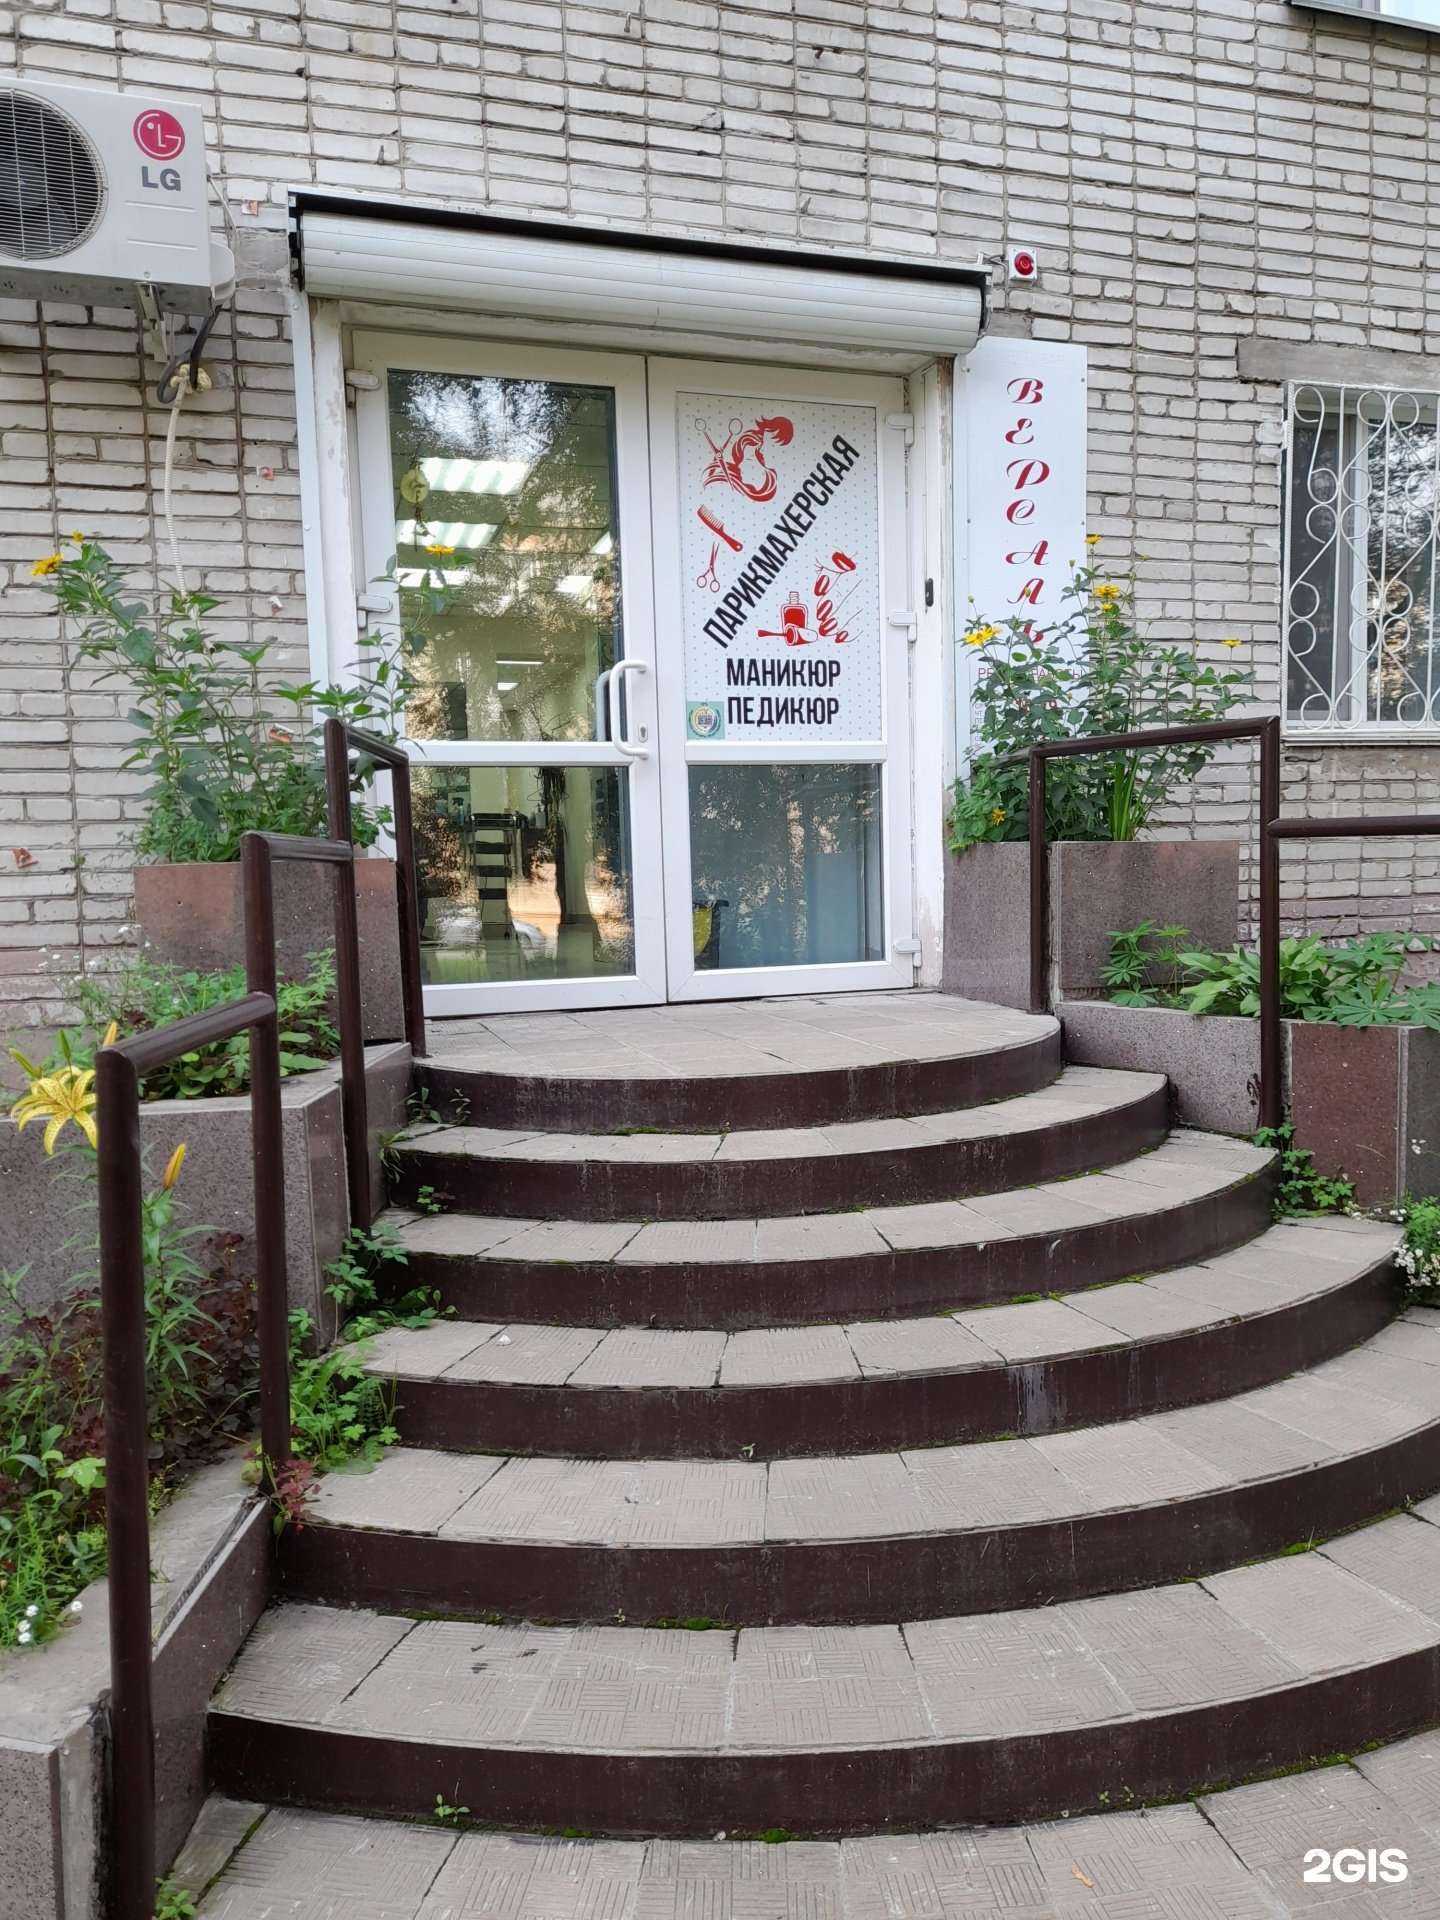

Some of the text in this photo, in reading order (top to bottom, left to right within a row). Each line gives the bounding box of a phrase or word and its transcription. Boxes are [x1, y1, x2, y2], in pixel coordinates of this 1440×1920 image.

[141, 166, 181, 191] LG
[703, 434, 860, 649] ПАРИКМАХЕРСКАЯ
[726, 658, 841, 688] МАНИКЮР
[727, 696, 839, 728] ПЕДИКЮР
